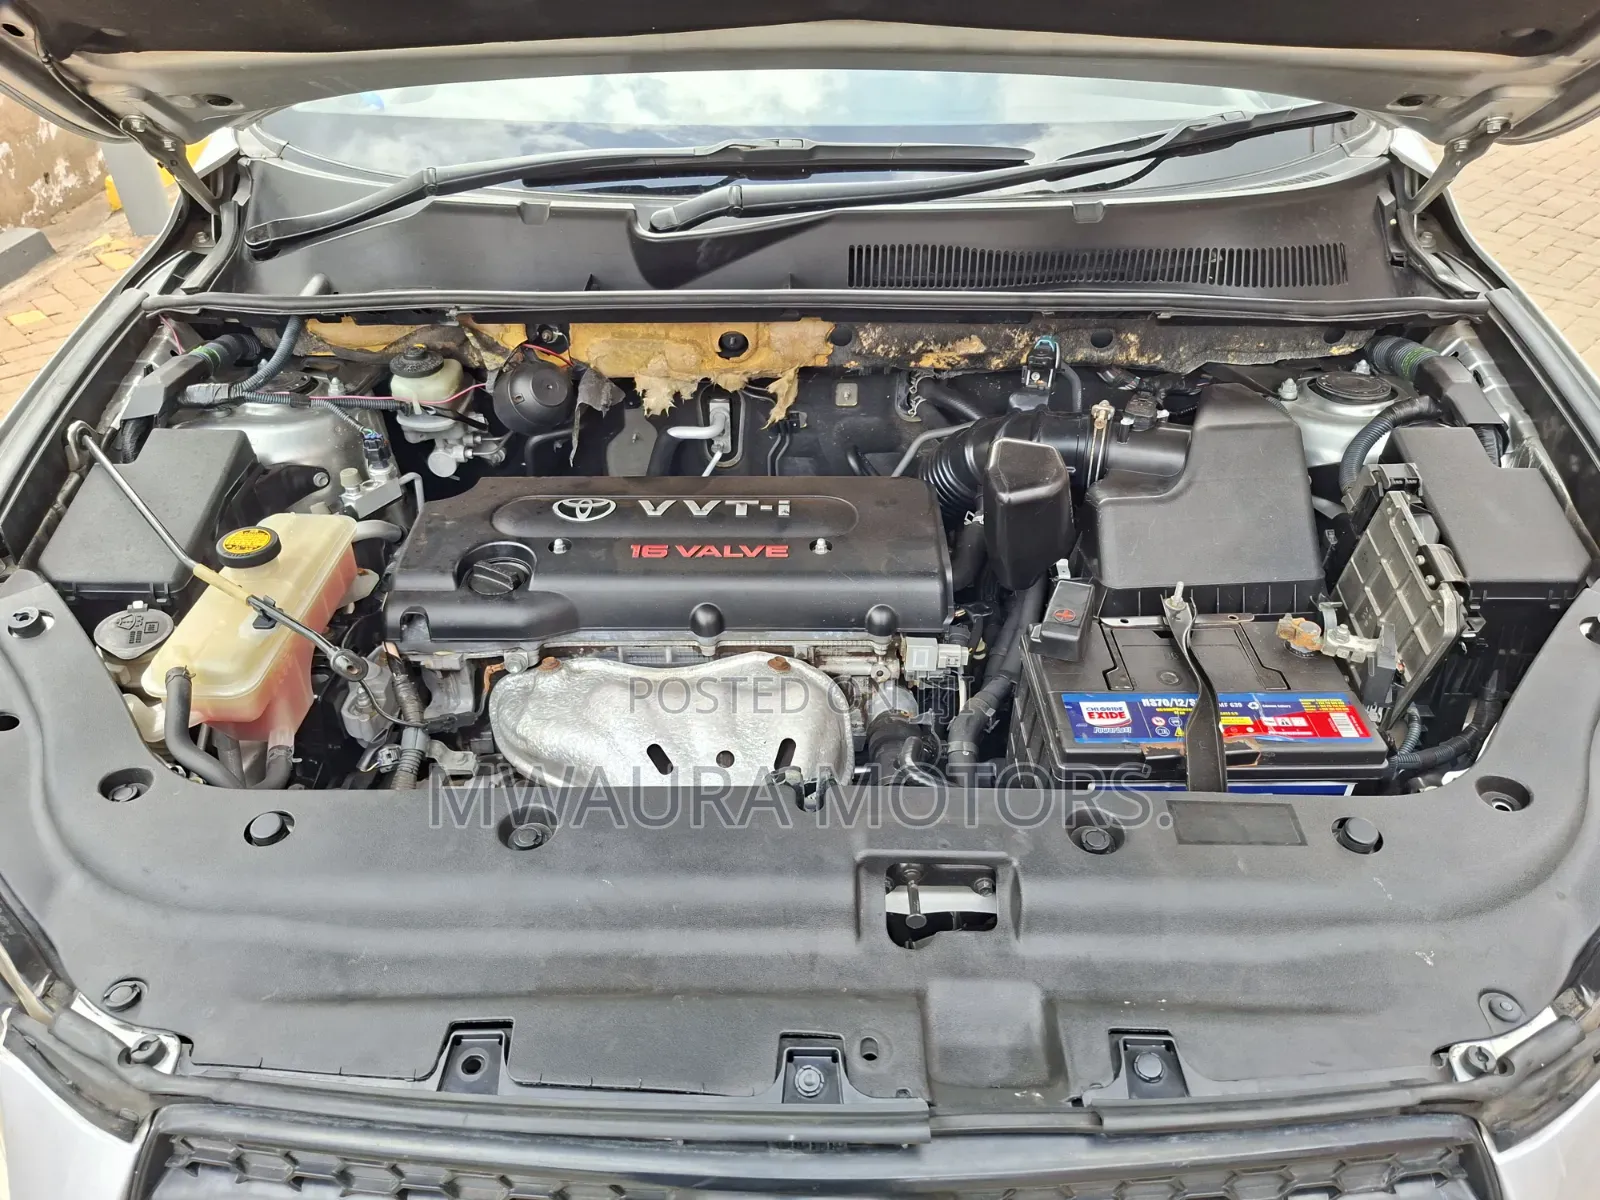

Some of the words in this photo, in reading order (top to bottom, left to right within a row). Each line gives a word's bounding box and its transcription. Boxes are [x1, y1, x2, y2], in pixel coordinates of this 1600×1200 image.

[637, 499, 791, 517] VVT-i
[631, 544, 669, 558] 16
[674, 544, 789, 558] VALVE
[1087, 711, 1126, 719] EXIDE
